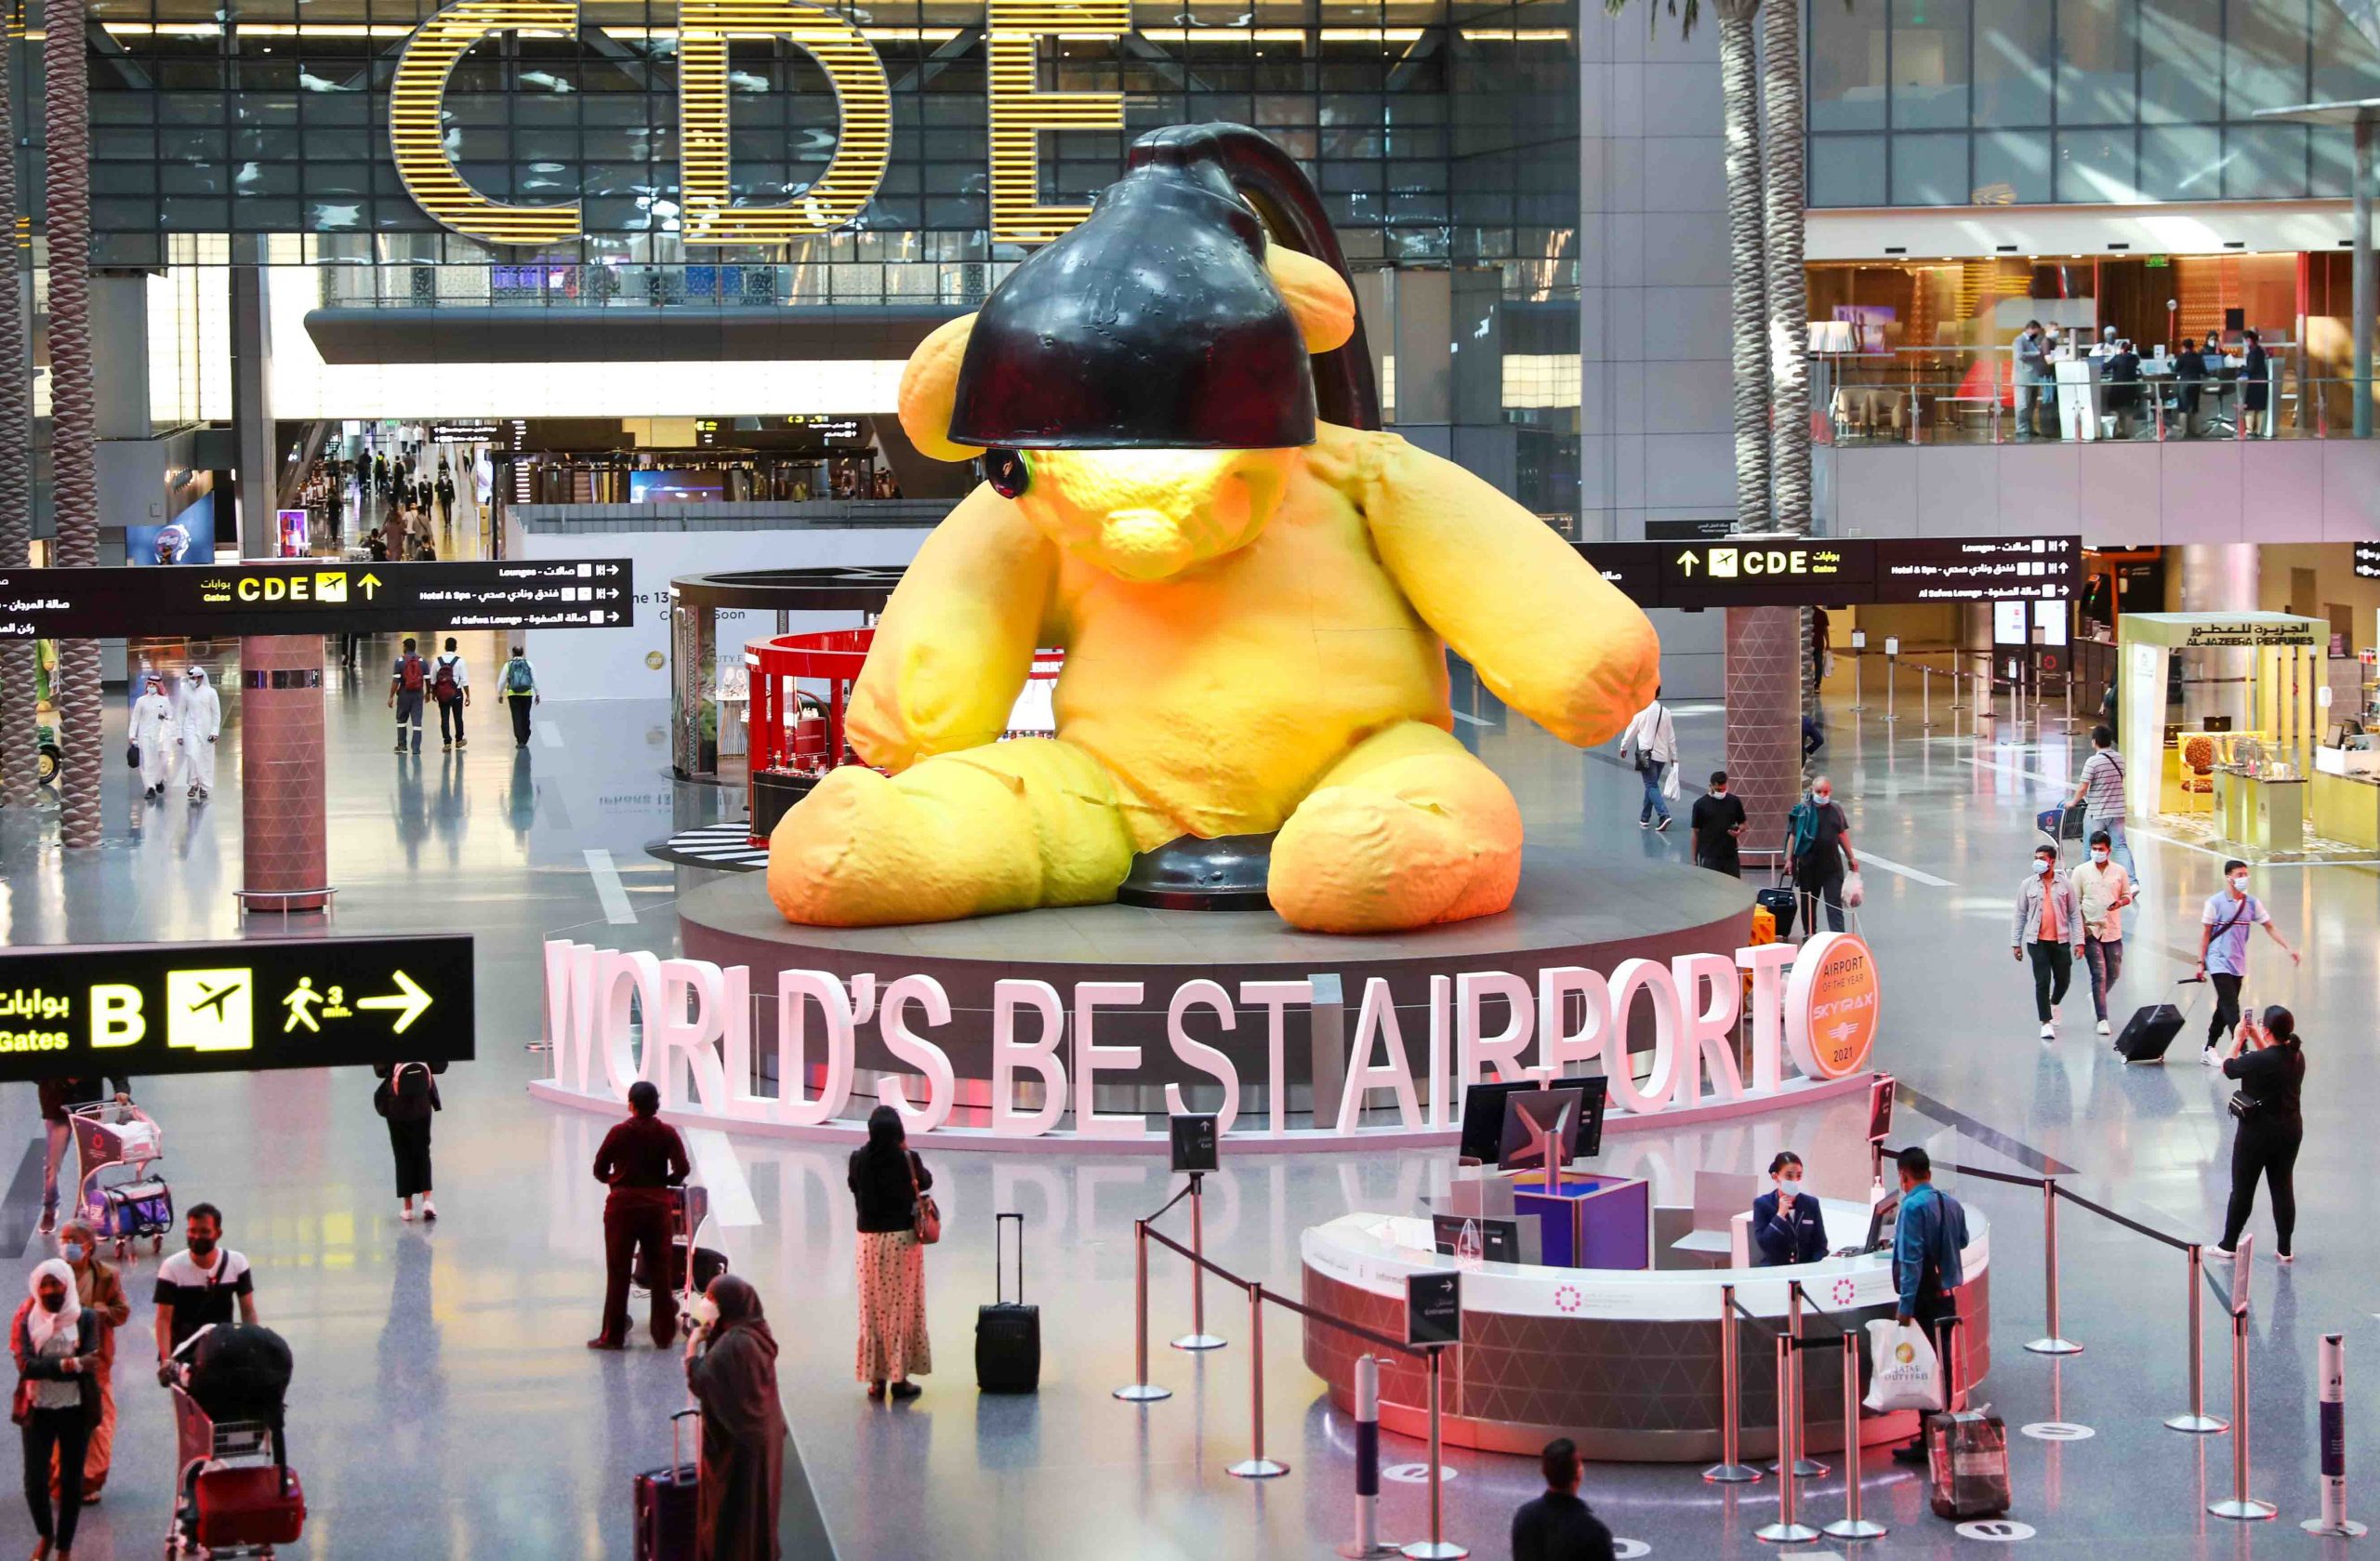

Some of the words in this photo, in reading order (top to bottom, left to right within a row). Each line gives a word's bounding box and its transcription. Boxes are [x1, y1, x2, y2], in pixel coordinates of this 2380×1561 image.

[390, 0, 582, 245] C
[679, 0, 892, 246] D
[988, 0, 1133, 245] E
[1962, 544, 1996, 554] Lounges
[2002, 541, 2030, 552] صالات
[1743, 551, 1807, 575] CDE
[1813, 551, 1841, 562] بوابات
[499, 568, 537, 578] Lounges
[543, 566, 575, 576] صالات
[1813, 565, 1837, 574] Gates
[1891, 565, 1913, 575] Hotel
[1913, 565, 1921, 575] &
[1921, 565, 1937, 576] Spa
[1992, 563, 2016, 575] فندق
[201, 578, 231, 590] بوابات
[238, 576, 310, 602] CDE
[204, 593, 231, 602] Gates
[419, 591, 444, 601] Hotel
[444, 591, 453, 601] &
[453, 591, 471, 602] Spa
[477, 590, 507, 602] صحي
[507, 589, 533, 602] ونادي
[534, 589, 560, 601] فندق
[654, 591, 668, 603] 13
[1919, 589, 1927, 598] Al
[1928, 589, 1952, 599] Safwa
[1952, 589, 1982, 599] Lounge
[2020, 586, 2042, 596] صالة
[8, 599, 45, 612] المرجان
[45, 599, 71, 609] صالة
[451, 615, 461, 625] Al
[461, 615, 490, 626] Safwa
[490, 615, 522, 626] Lounge
[529, 613, 563, 625] الصفوة
[564, 613, 588, 623] صالة
[715, 609, 746, 620] Soon
[17, 623, 35, 634] ركن
[2190, 623, 2252, 637] للعطور
[2254, 623, 2309, 636] الجزيرة
[2187, 637, 2254, 646] AL-JAZEERA
[2256, 637, 2315, 646] PERFUMES
[1823, 955, 1864, 978] AIRPORT
[1822, 981, 1831, 993] OF
[1832, 977, 1845, 991] THE
[1847, 973, 1865, 988] YEAR
[327, 986, 344, 1004] 3
[0, 987, 70, 1020] بوابات
[1813, 991, 1875, 1021] SKYTRAX
[90, 984, 146, 1049] B
[322, 1004, 353, 1019] min.
[0, 1029, 70, 1053] Gates
[1336, 942, 1798, 1135] AIRPORT
[993, 977, 1313, 1140] BEST
[1833, 1046, 1854, 1063] 2021
